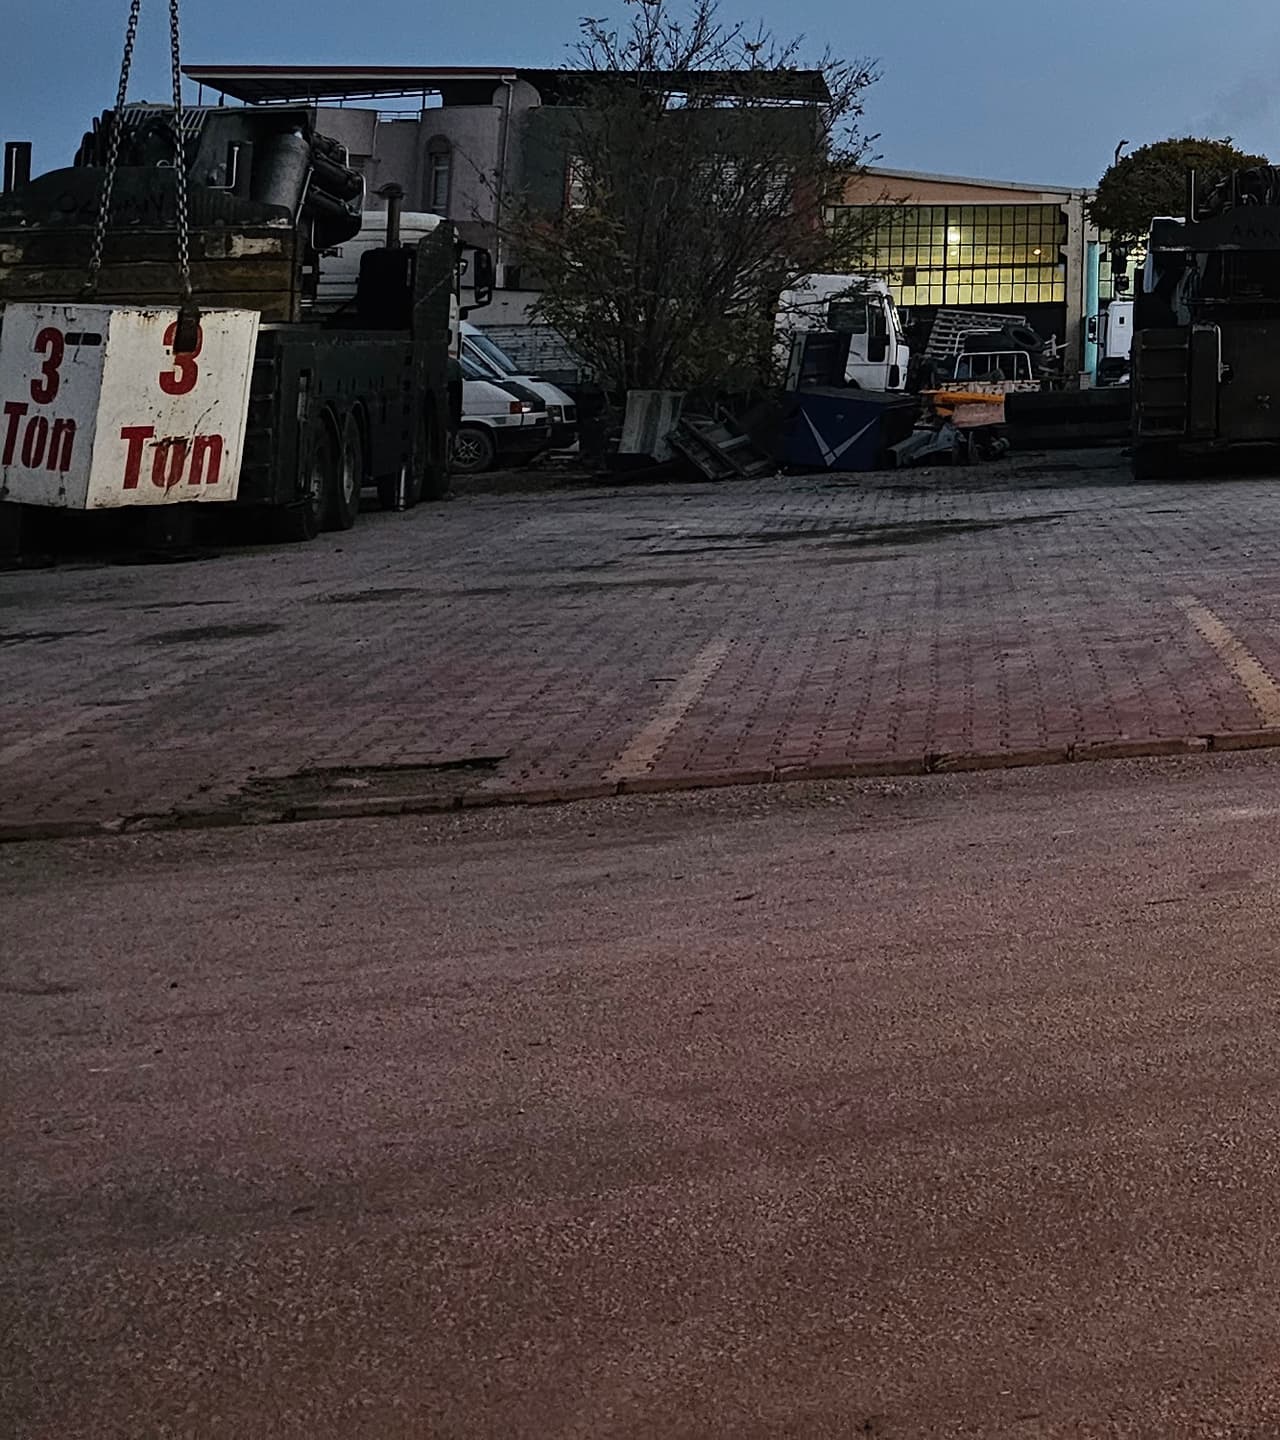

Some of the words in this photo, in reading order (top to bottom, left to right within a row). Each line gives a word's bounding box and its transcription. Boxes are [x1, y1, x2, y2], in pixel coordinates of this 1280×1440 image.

[30, 326, 65, 405] 3
[158, 319, 204, 396] 3
[2, 401, 77, 472] Ton
[120, 426, 224, 489] Ton
